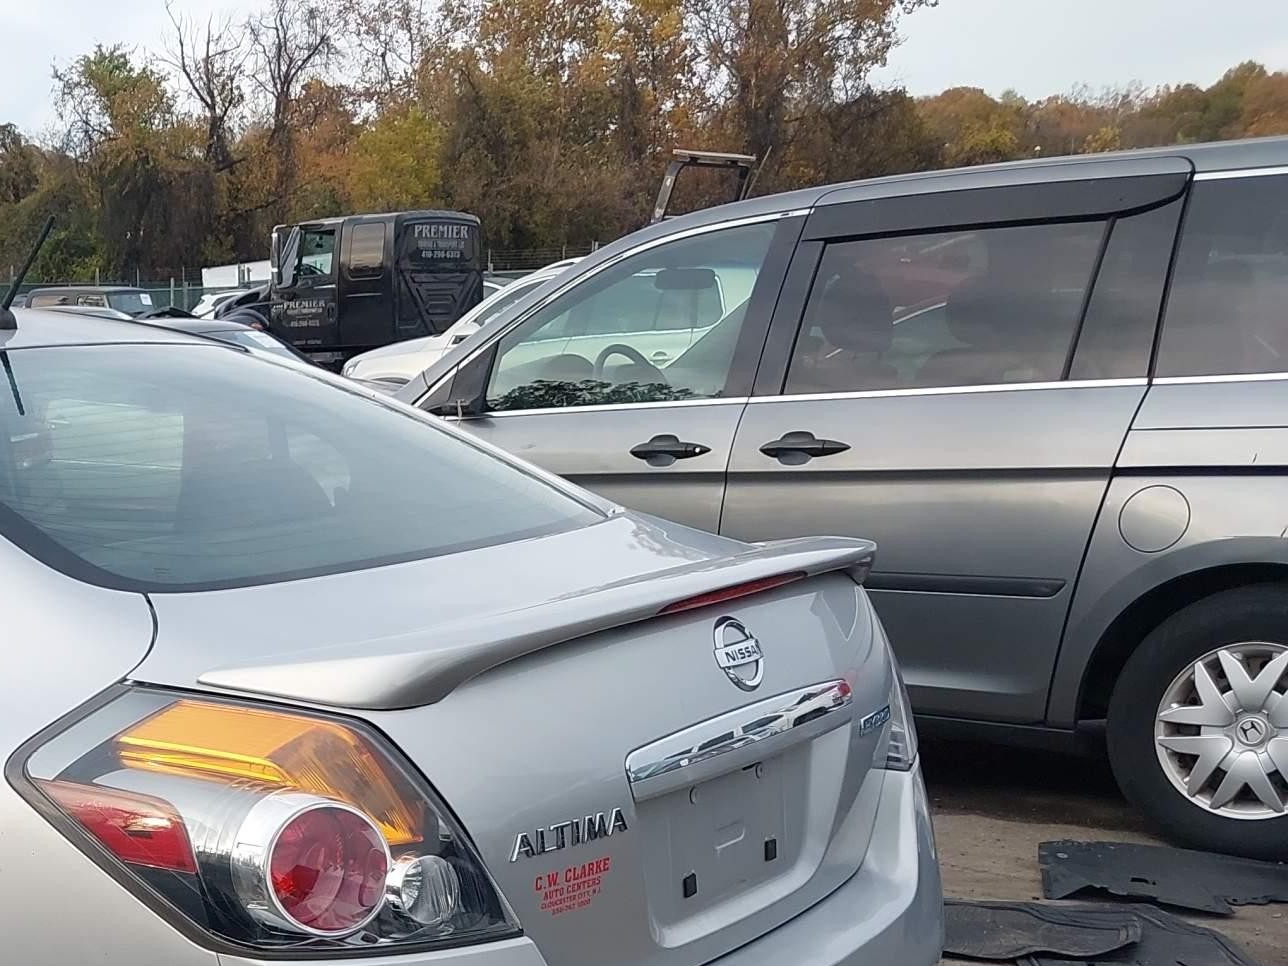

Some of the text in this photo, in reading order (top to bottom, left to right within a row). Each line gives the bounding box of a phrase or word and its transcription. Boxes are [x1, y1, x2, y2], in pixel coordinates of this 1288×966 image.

[414, 224, 469, 239] PREMIER
[283, 300, 326, 309] PREMIER
[509, 807, 628, 863] ALTIMA
[565, 857, 611, 883] CLARKE
[544, 876, 601, 901] AUTO CENTERS
